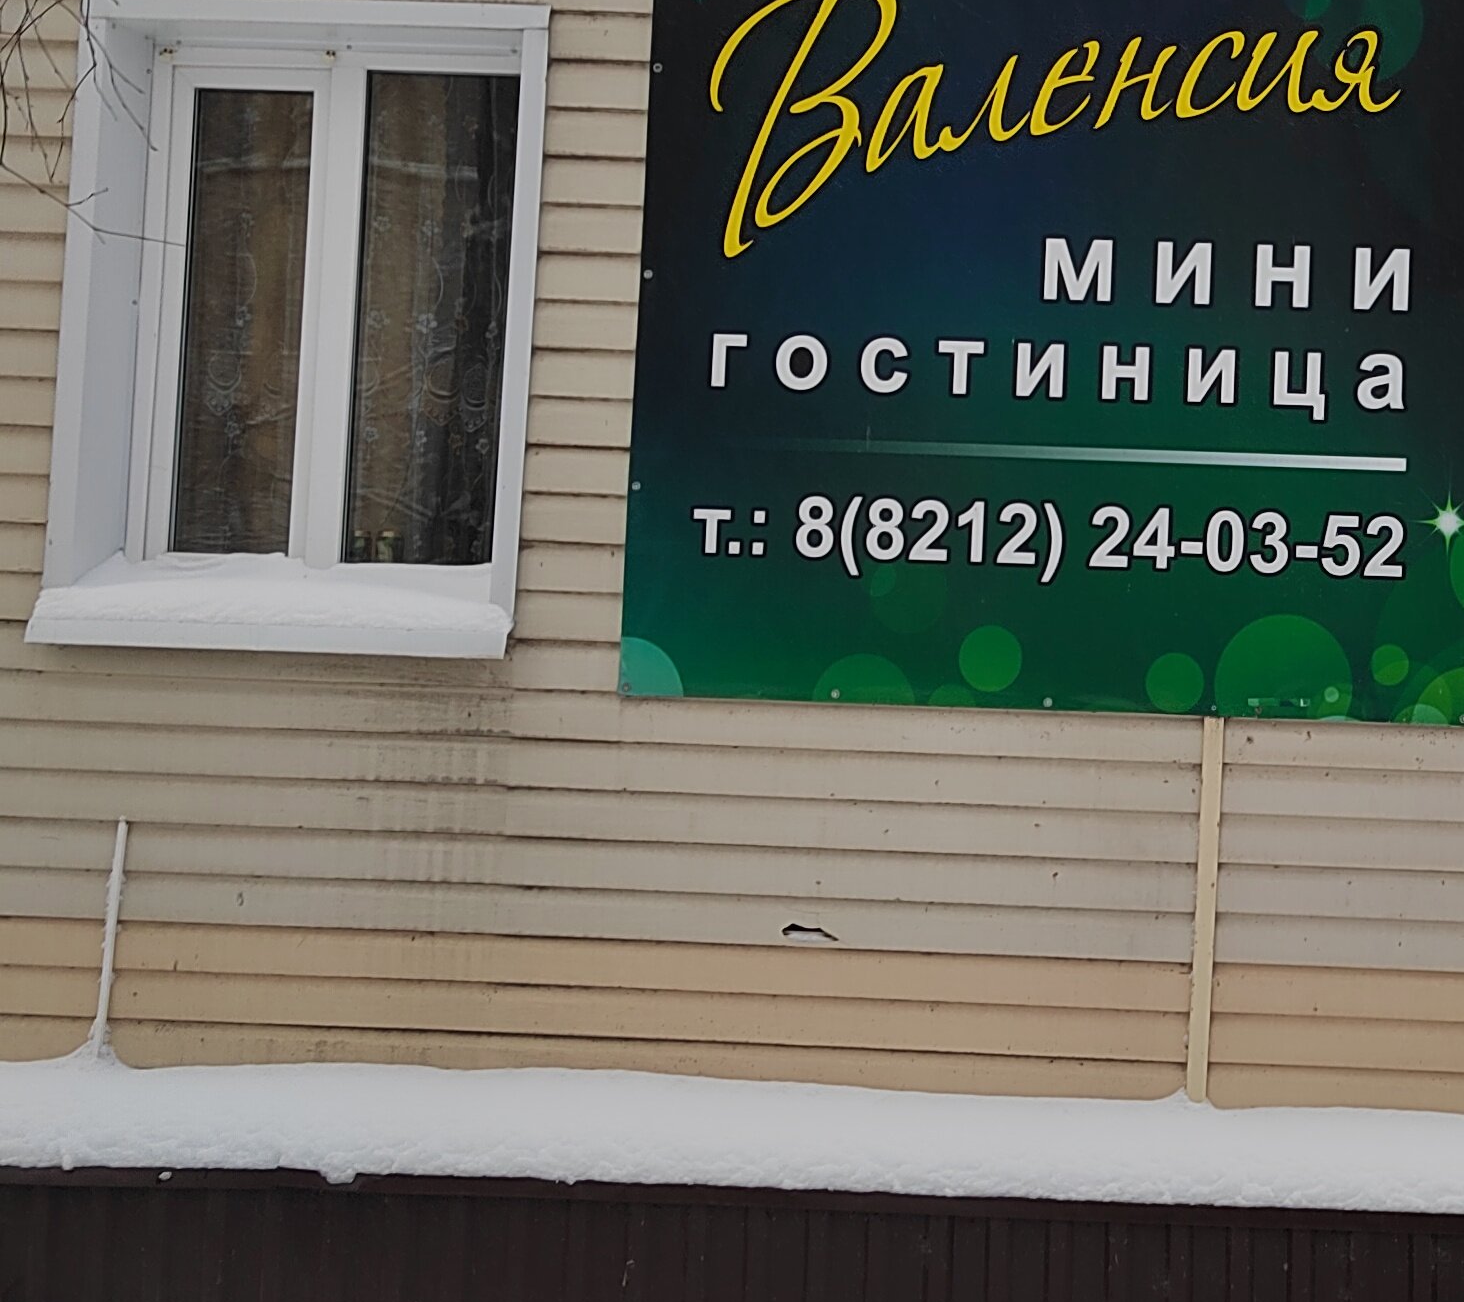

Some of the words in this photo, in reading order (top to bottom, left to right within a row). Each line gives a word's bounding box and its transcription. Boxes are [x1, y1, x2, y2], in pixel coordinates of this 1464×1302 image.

[709, 332, 1406, 422] гостиница
[692, 507, 767, 556] т.:
[794, 494, 1064, 584] 8(8212)
[1087, 505, 1405, 579] 24-03-52
